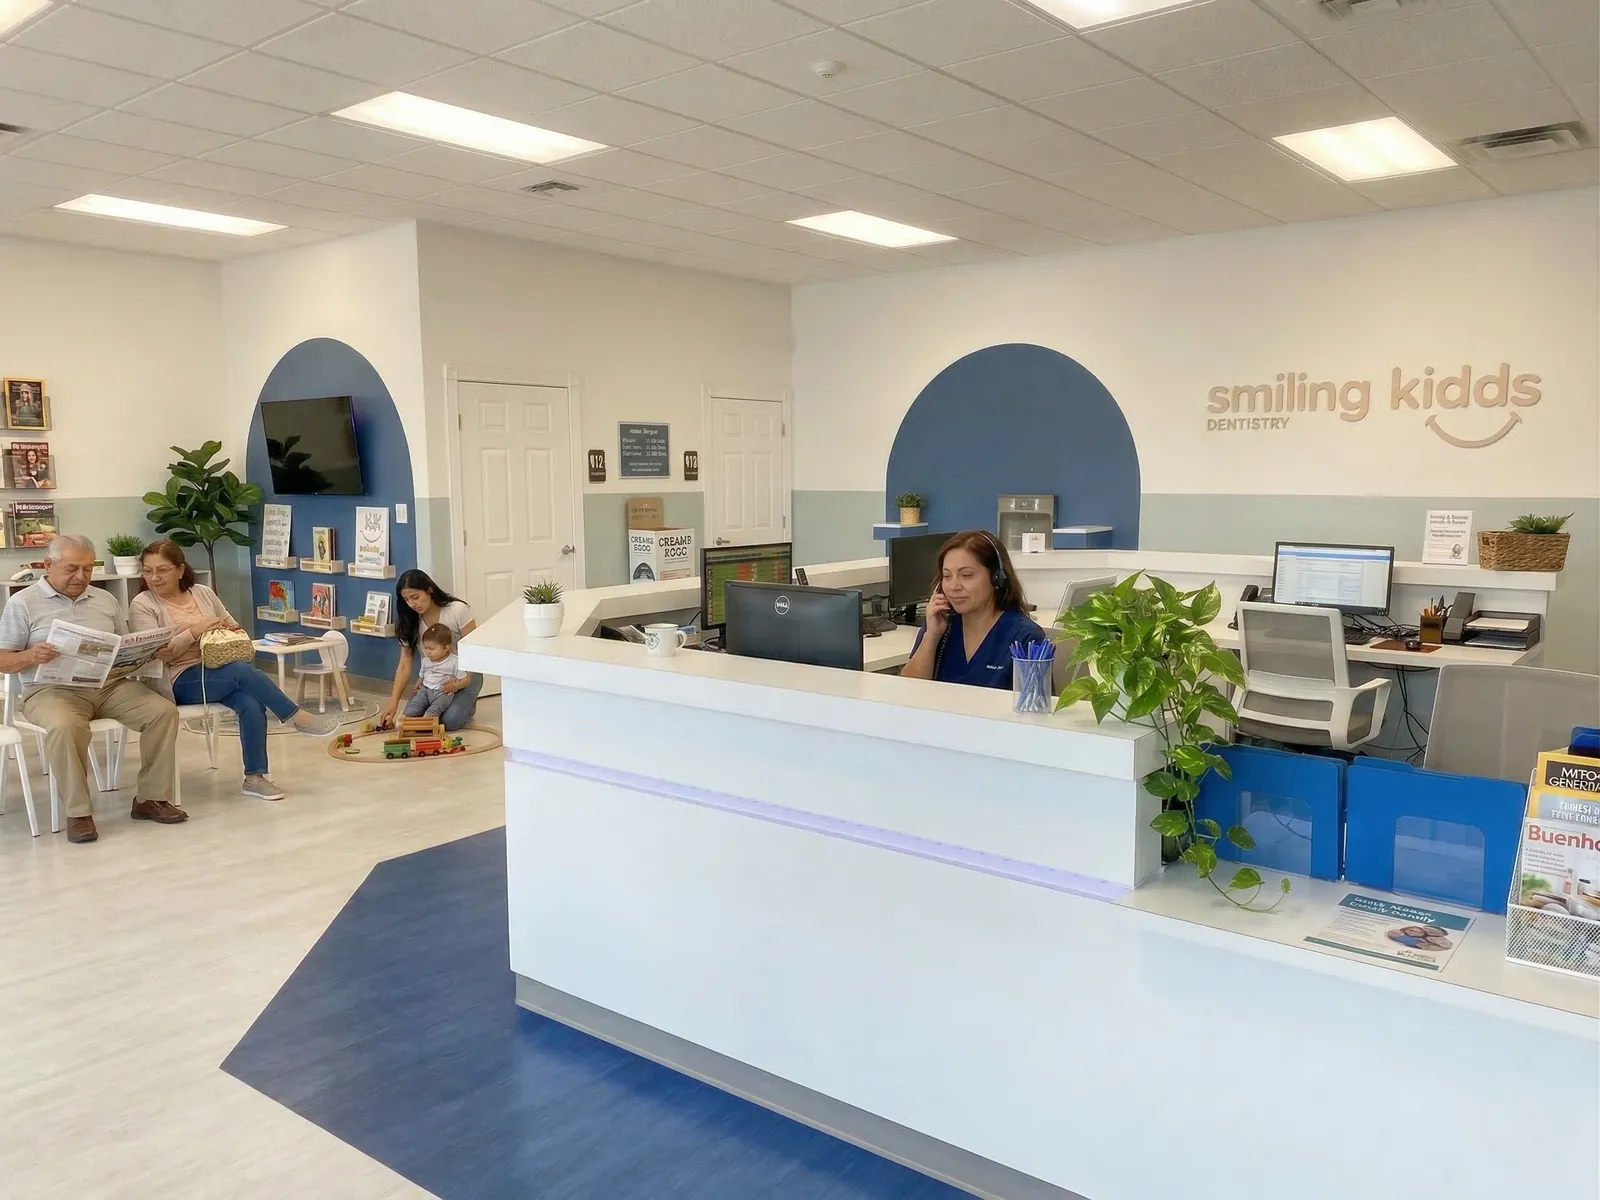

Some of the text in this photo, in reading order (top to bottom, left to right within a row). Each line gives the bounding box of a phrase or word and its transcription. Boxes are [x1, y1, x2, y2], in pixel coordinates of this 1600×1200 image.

[1207, 362, 1542, 423] smiling kidds
[1207, 416, 1290, 432] DENTISTRY
